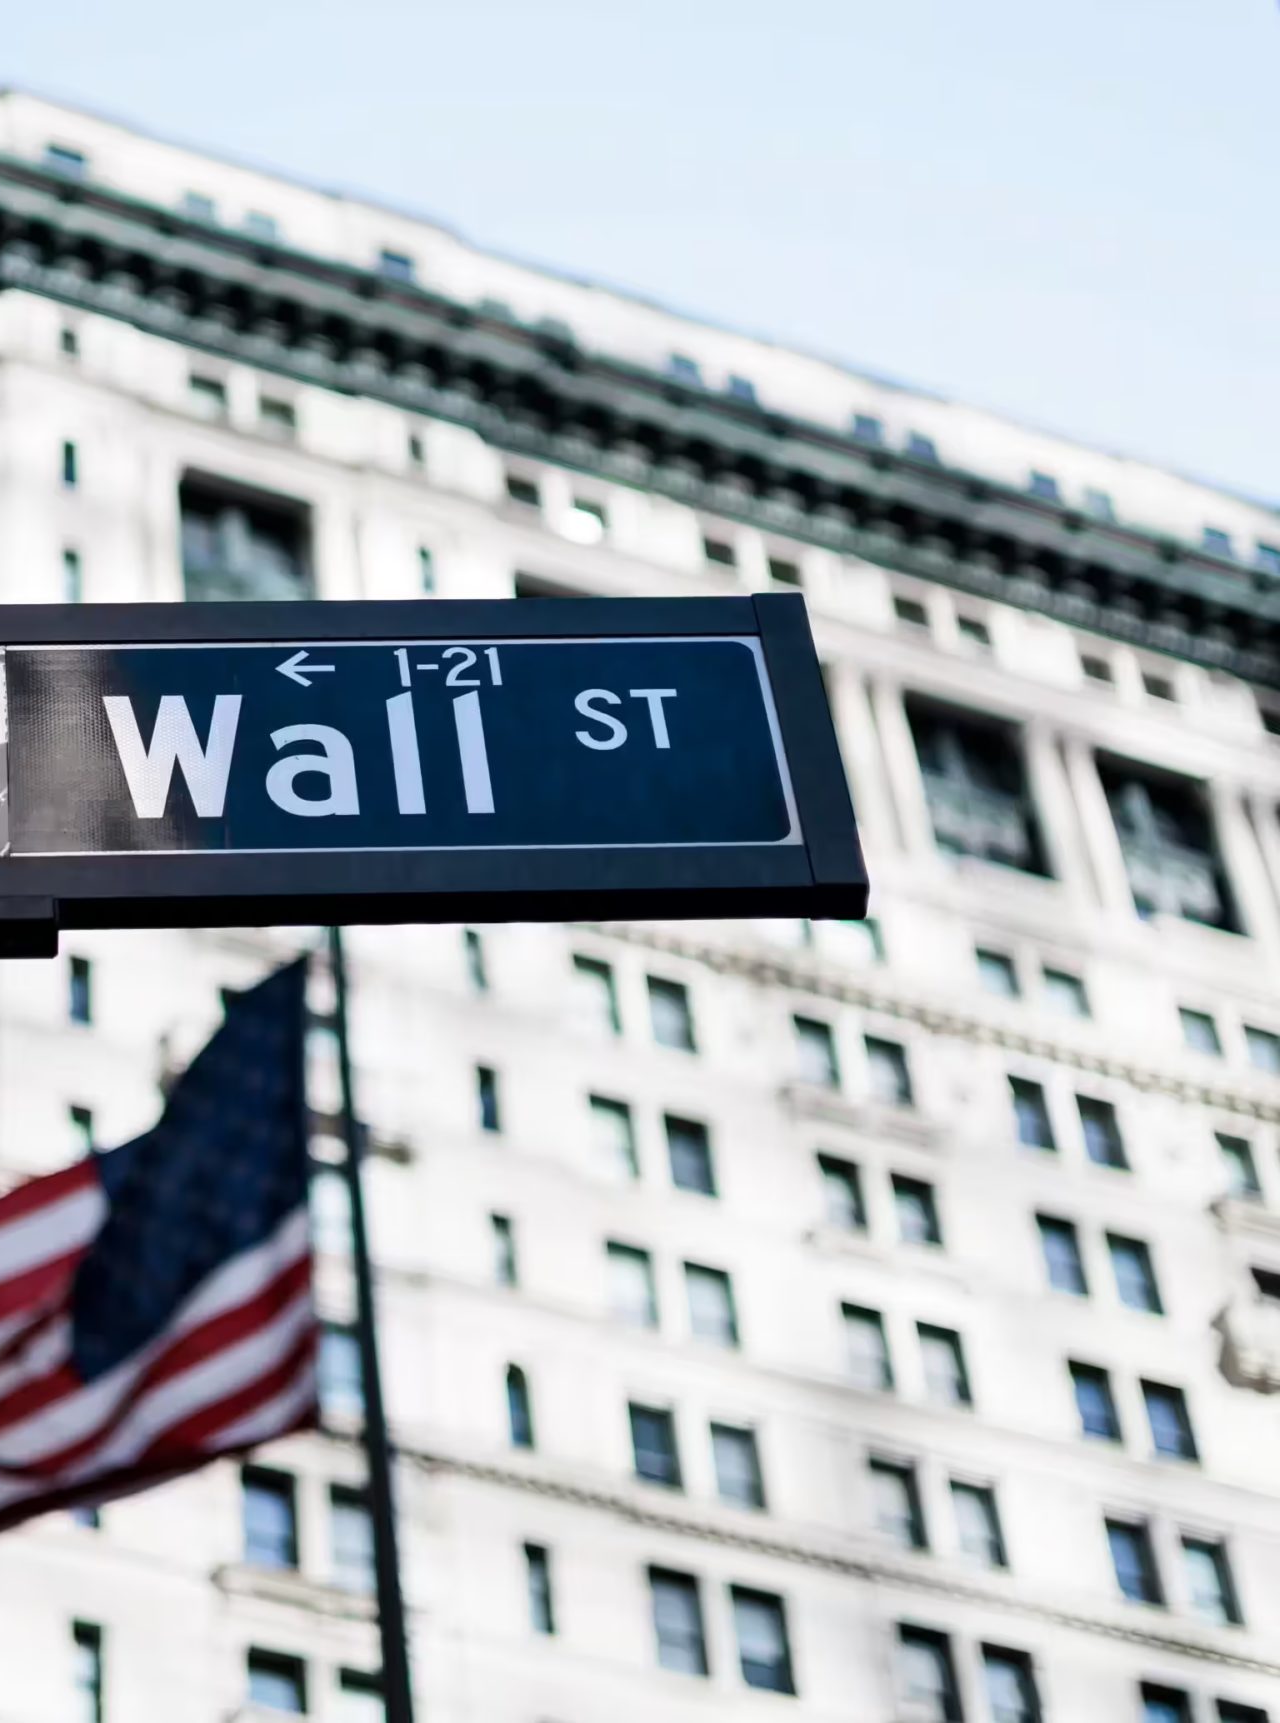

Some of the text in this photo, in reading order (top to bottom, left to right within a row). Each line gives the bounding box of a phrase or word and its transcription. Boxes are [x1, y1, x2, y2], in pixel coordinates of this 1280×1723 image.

[393, 646, 503, 687] 1-21
[102, 688, 678, 820] Wall ST
